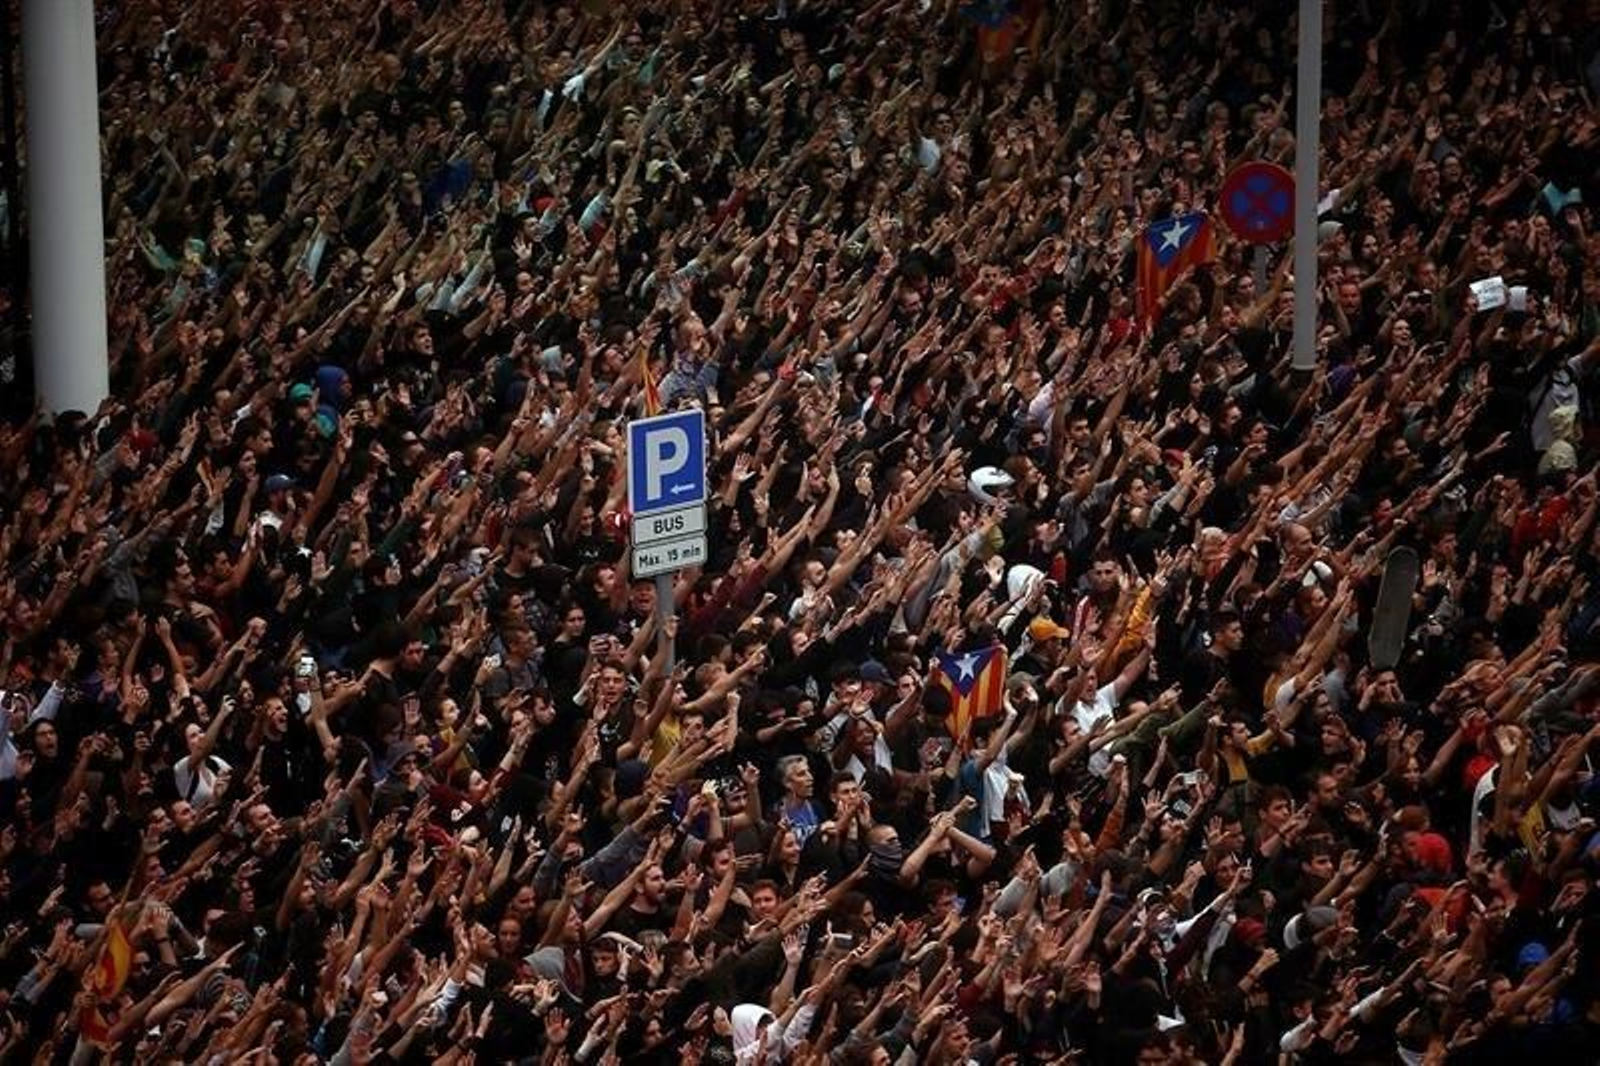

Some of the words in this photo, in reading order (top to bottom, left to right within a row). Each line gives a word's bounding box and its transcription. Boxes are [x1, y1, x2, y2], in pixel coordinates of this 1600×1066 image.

[645, 427, 690, 501] P
[653, 515, 684, 534] BUS
[667, 549, 678, 562] 15
[682, 544, 701, 559] min
